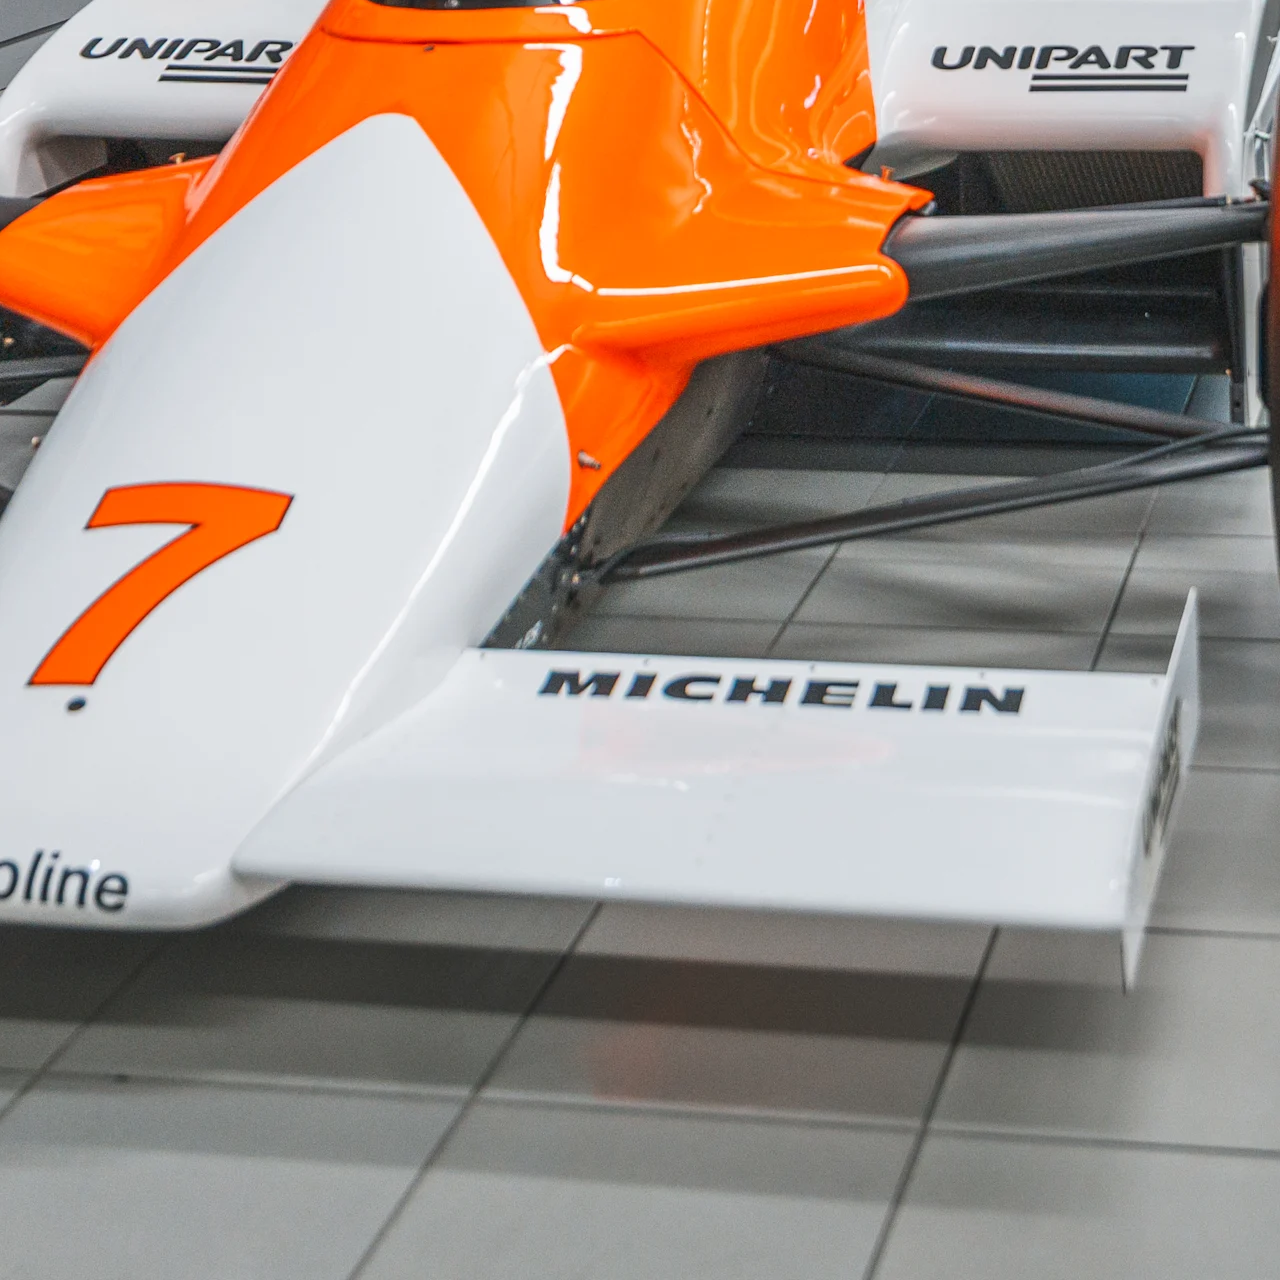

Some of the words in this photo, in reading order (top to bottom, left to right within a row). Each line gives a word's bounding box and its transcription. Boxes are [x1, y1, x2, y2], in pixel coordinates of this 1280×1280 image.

[80, 37, 299, 64] UNIPAR
[931, 45, 1196, 70] UNIPART
[27, 481, 295, 686] 7
[537, 669, 1026, 714] MICHELIN
